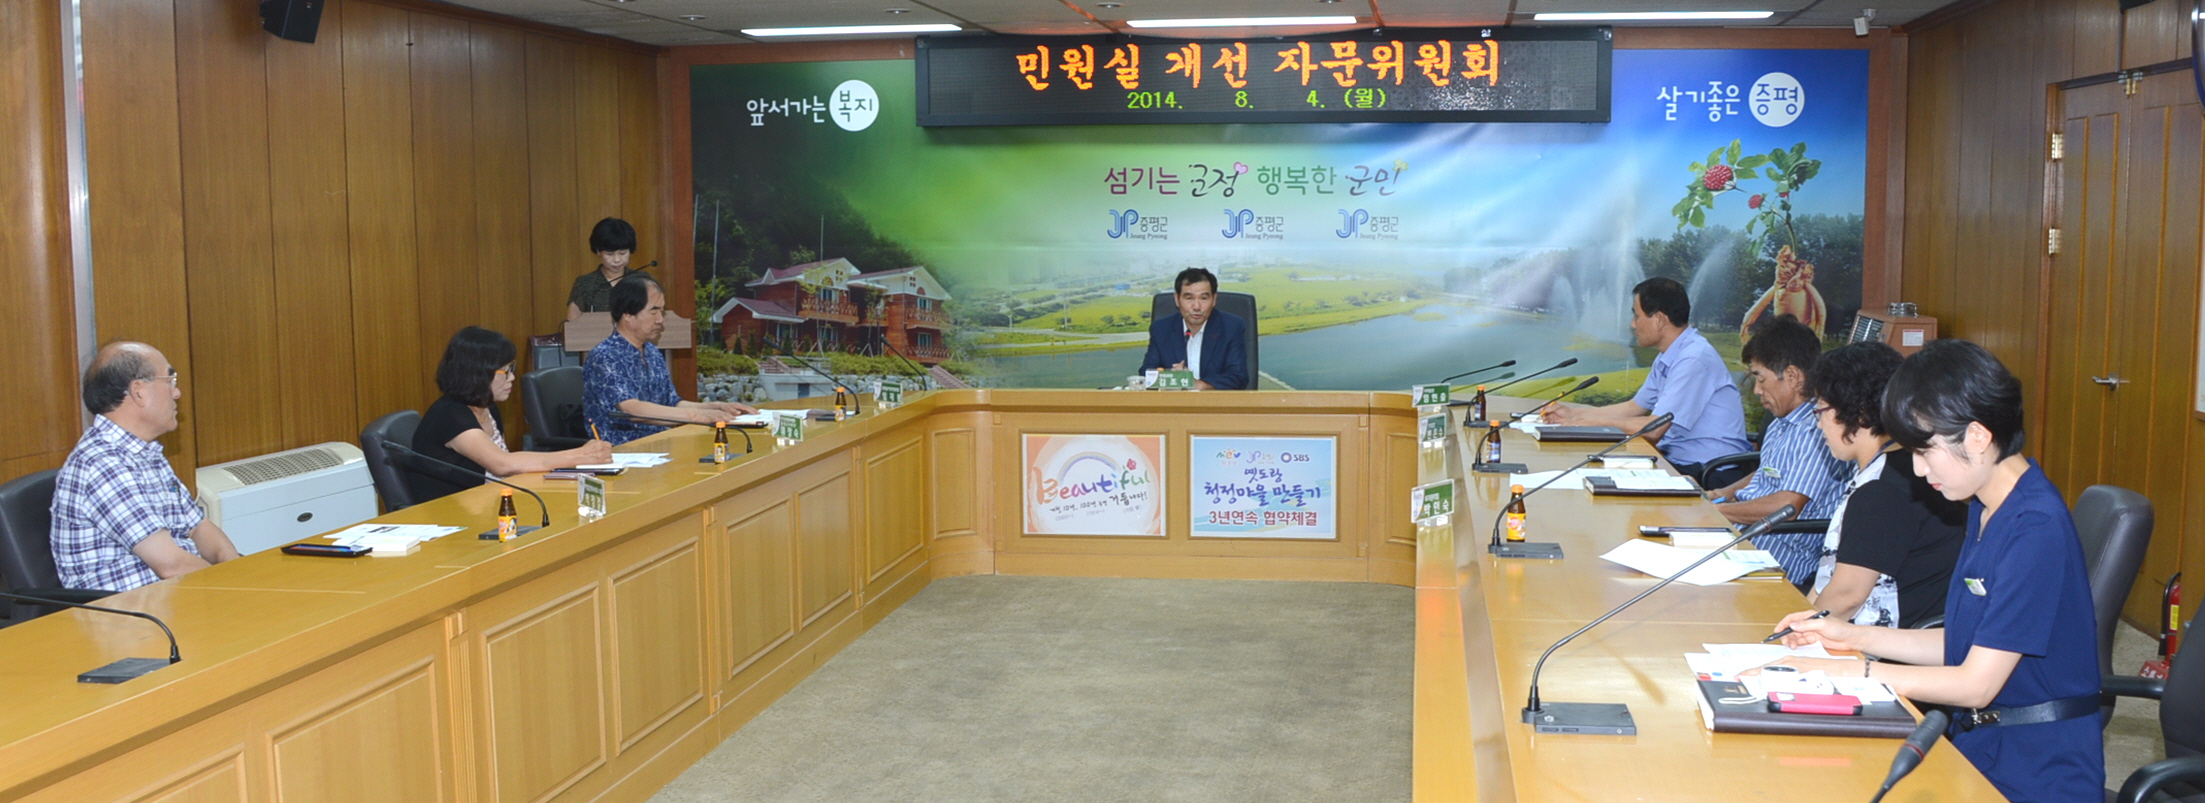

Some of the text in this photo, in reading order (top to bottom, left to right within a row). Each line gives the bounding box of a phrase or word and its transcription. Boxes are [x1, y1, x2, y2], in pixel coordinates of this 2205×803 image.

[1016, 39, 1499, 91] 민원실 개선 자문위원회
[746, 90, 873, 126] 앞서가는 복지
[1127, 87, 1386, 109] 2014. 8. 4. (월)
[1656, 81, 1799, 122] 살기좋은 증평
[1104, 167, 1180, 195] 섬기는
[1257, 165, 1337, 195] 행복한
[1345, 165, 1401, 196] 군민
[1140, 216, 1168, 232] 증평군
[1255, 216, 1283, 232] 증평군
[1370, 216, 1398, 232] 증평군
[1293, 454, 1310, 462] SBS
[1033, 466, 1151, 505] Beautiful
[1244, 467, 1283, 484] 옛도랑
[1204, 482, 1321, 507] 청정마을 만들기
[1209, 510, 1317, 526] 3년연속 협약체결
